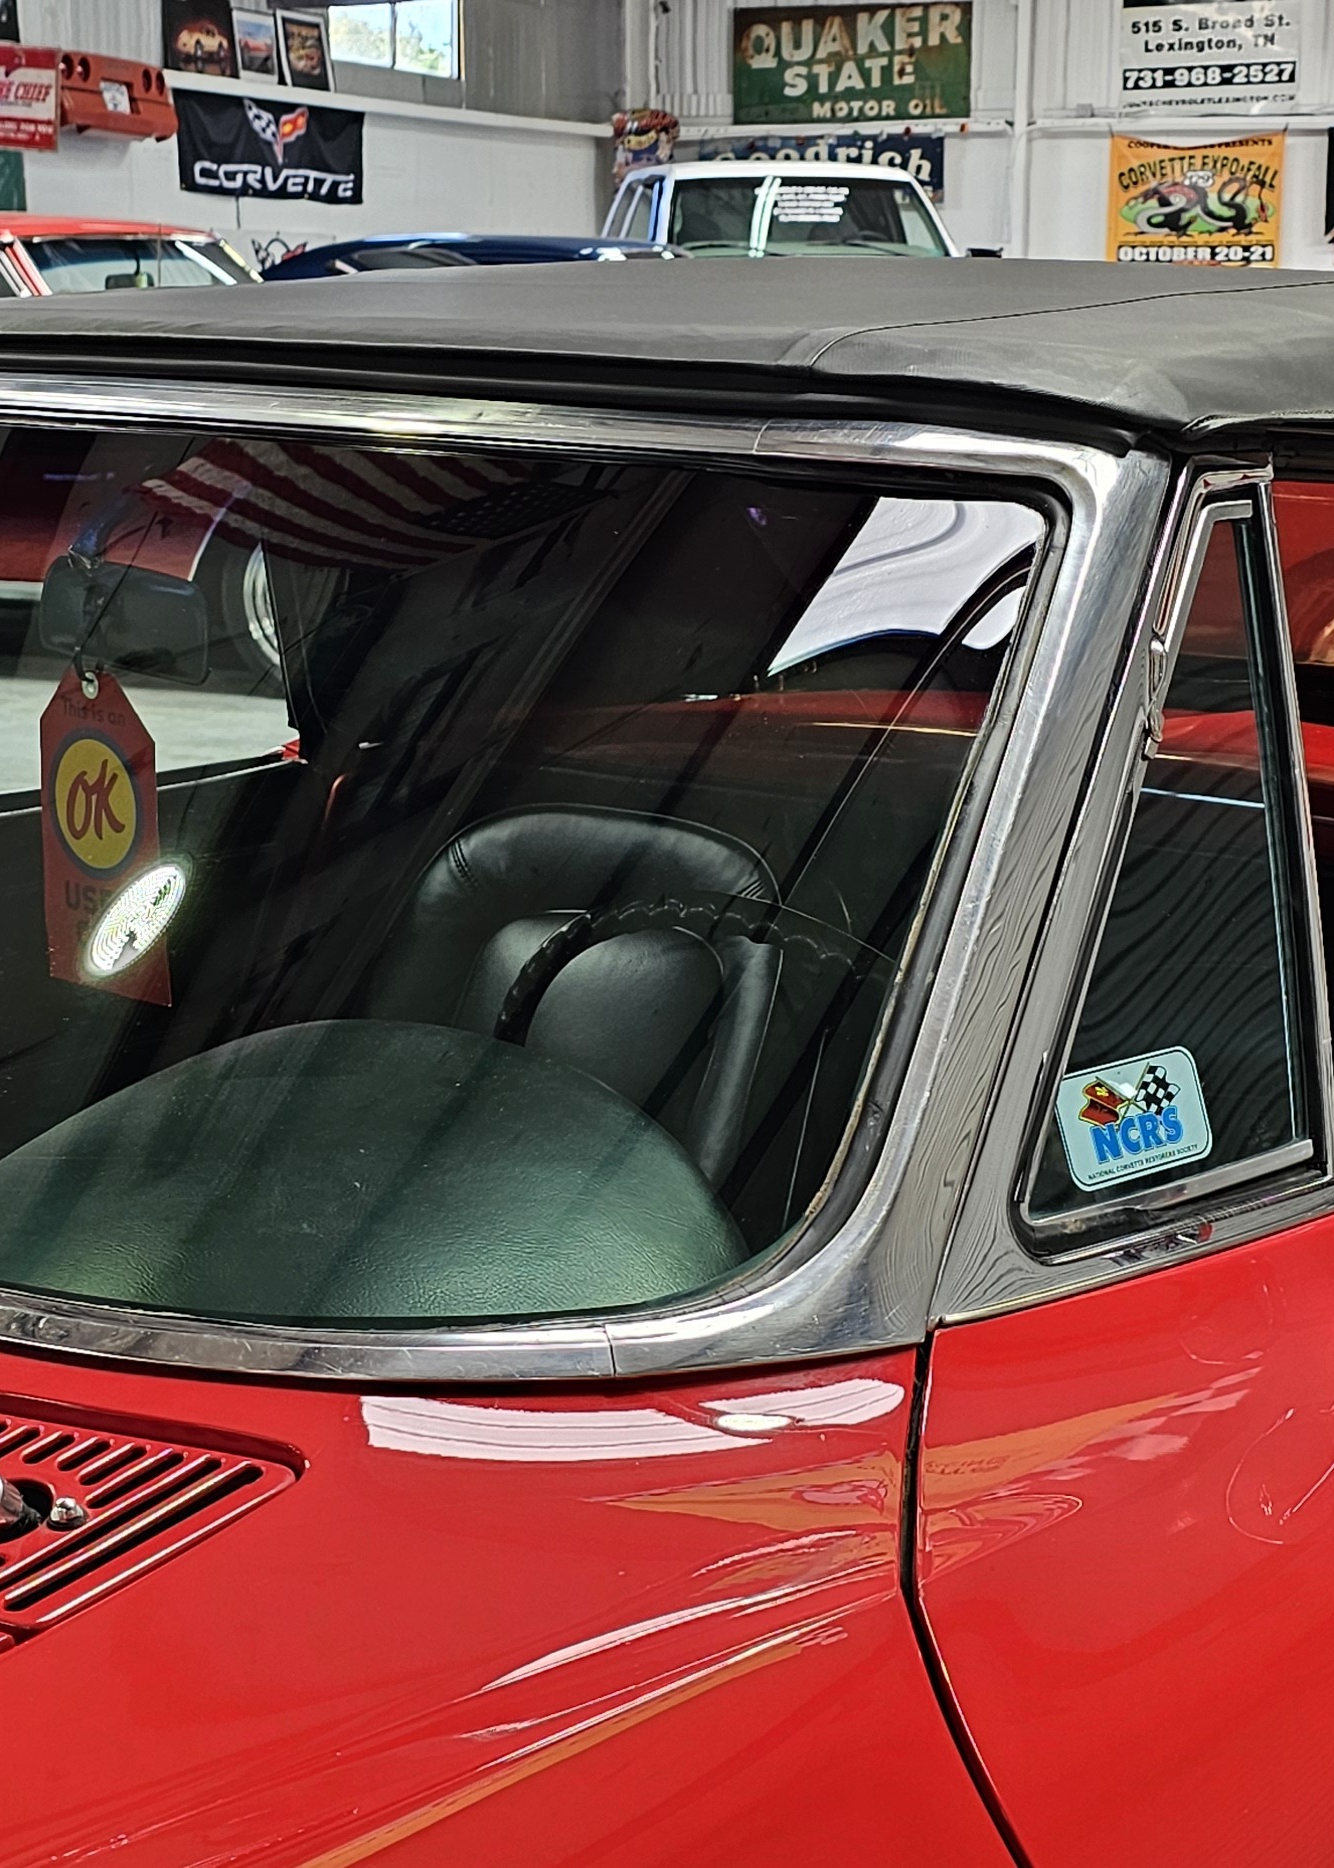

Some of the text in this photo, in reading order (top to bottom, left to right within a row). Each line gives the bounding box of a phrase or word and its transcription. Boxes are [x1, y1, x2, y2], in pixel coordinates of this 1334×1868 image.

[742, 4, 963, 69] QUAKER
[1131, 14, 1291, 34] 515 S. Broad St.
[1144, 33, 1276, 52] Lexington, TN
[783, 54, 916, 97] STATE
[1124, 63, 1295, 89] 731-968-2527
[812, 97, 947, 118] MOTOR OIL
[194, 160, 355, 198] CORVETTE
[1118, 155, 1196, 191] CORVETTE
[1118, 245, 1274, 261] OCTOBER 20-21
[67, 758, 126, 841] OK
[1090, 1106, 1183, 1165] NCRS
